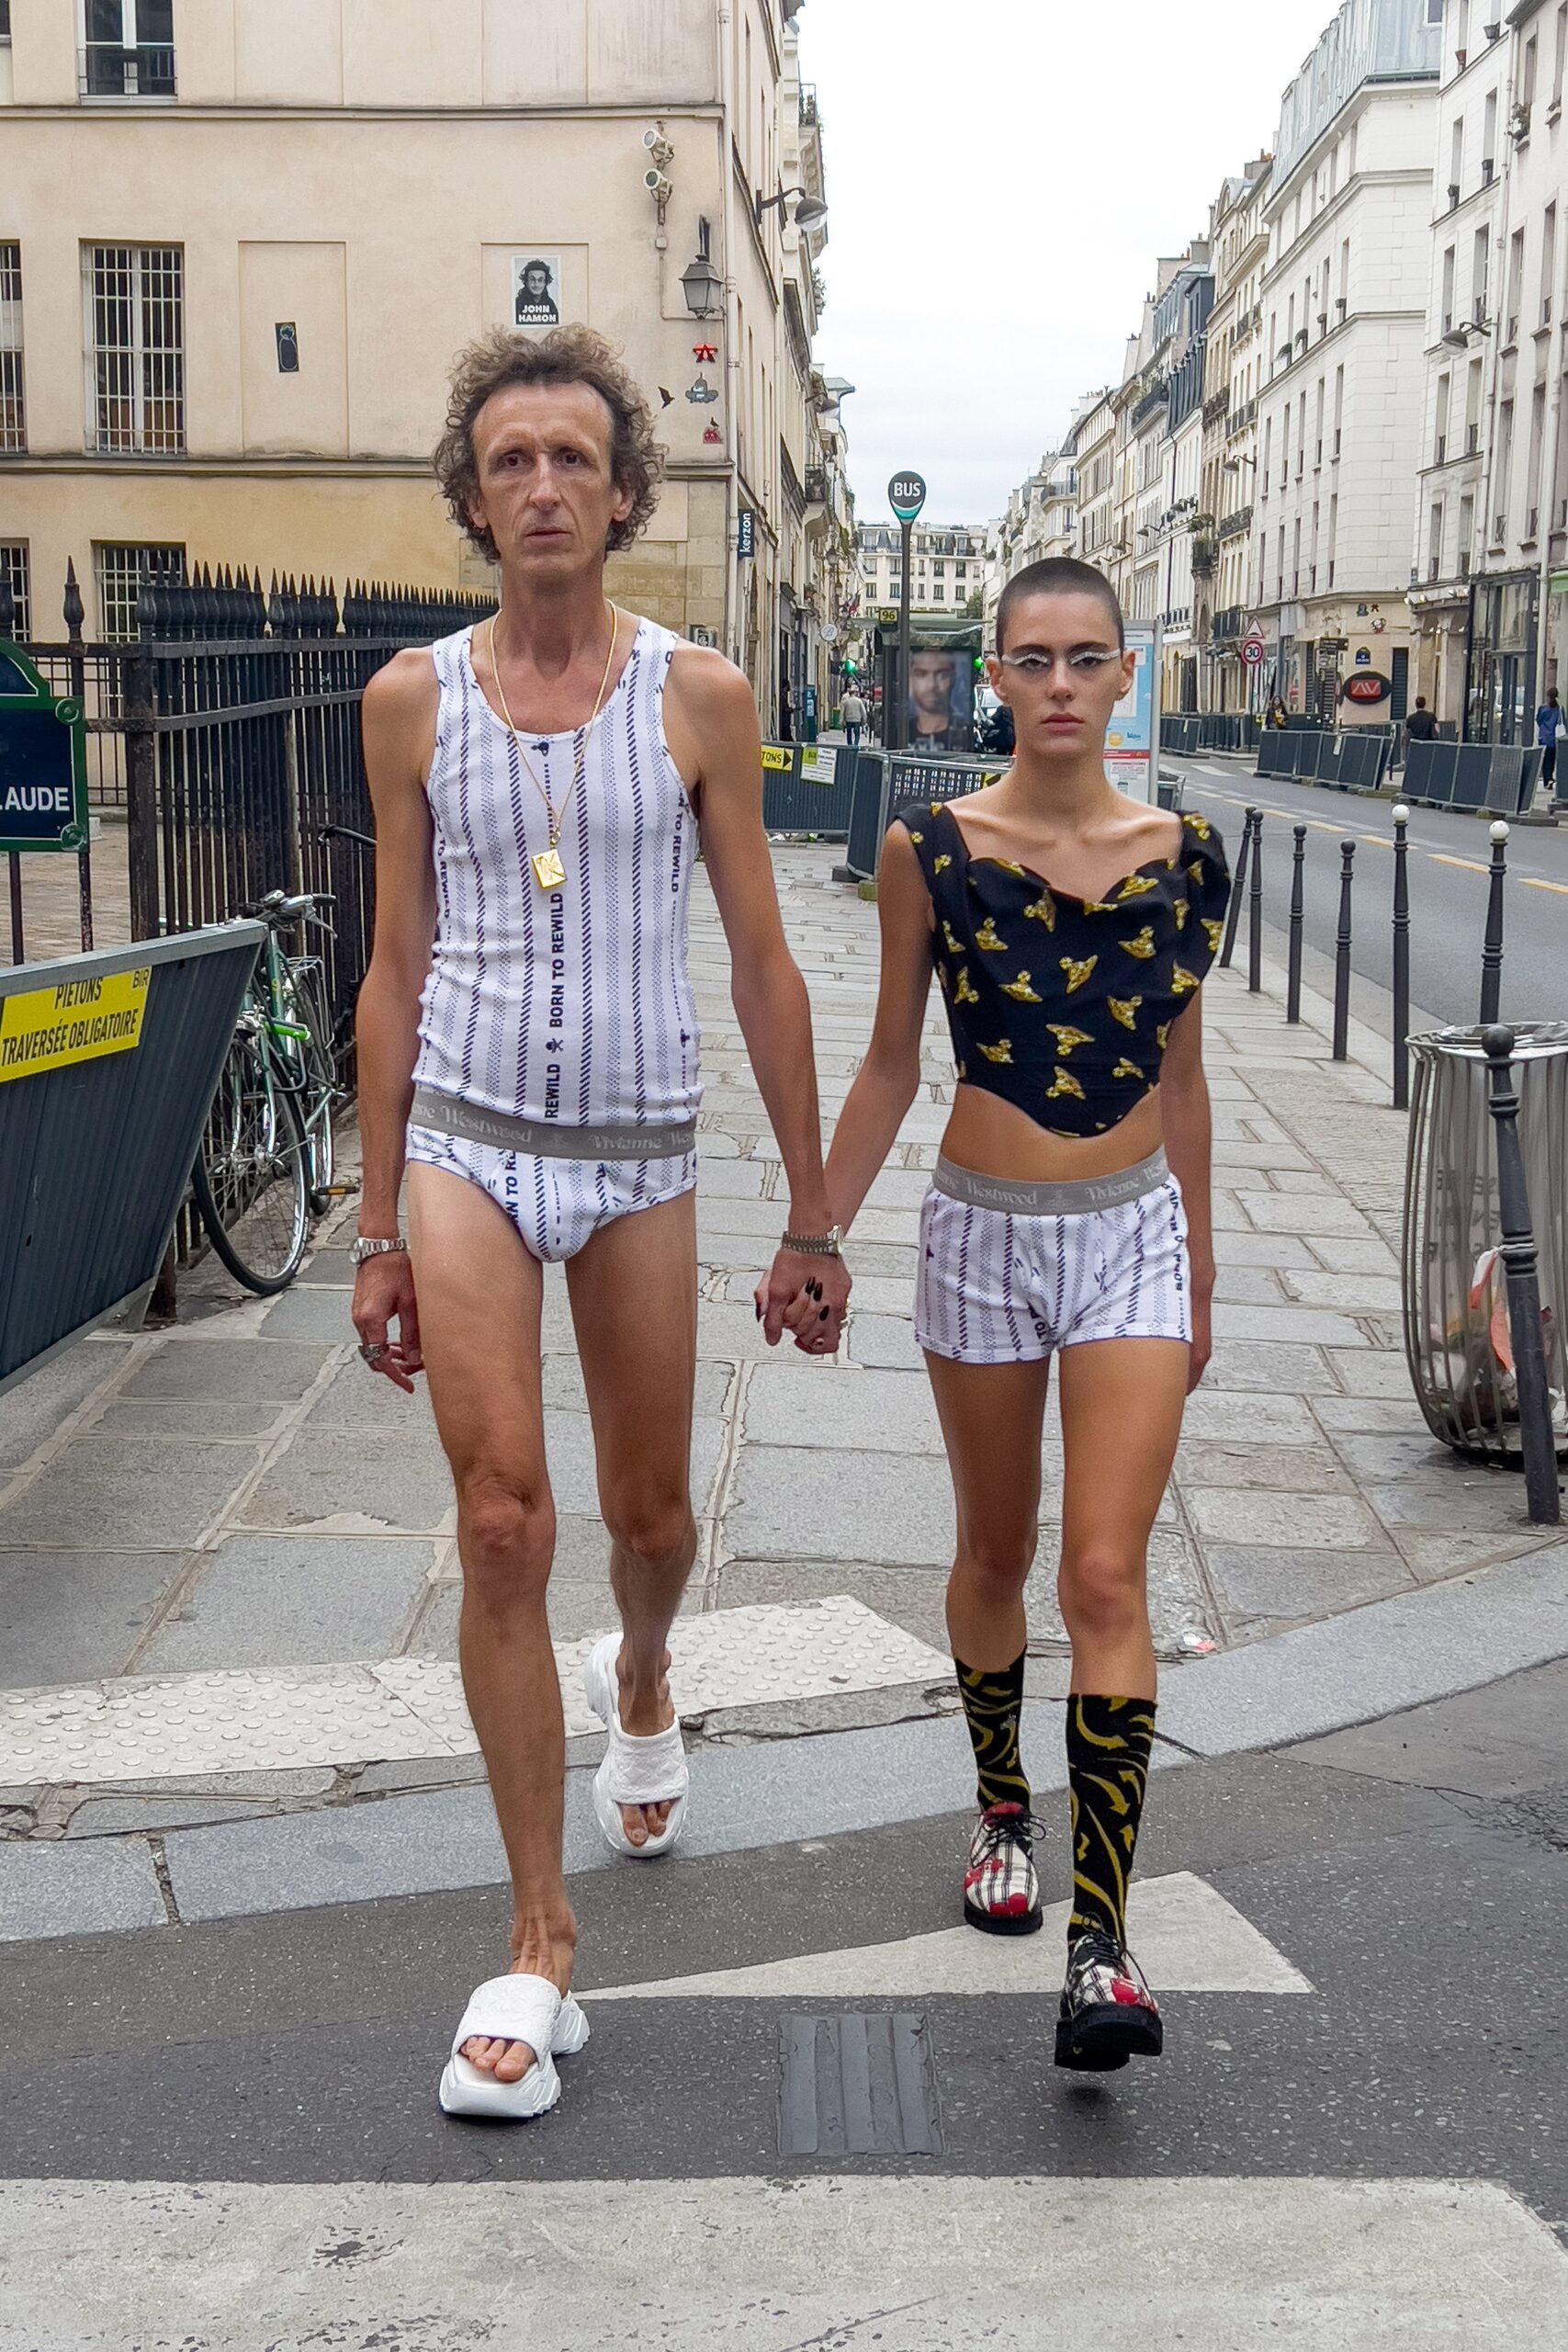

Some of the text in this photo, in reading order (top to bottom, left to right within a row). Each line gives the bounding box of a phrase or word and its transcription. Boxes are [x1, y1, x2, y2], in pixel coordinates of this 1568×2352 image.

[518, 313, 557, 322] HAMON
[522, 304, 550, 313] JOHN
[894, 481, 921, 497] BUS
[739, 513, 751, 553] kerzon
[882, 610, 896, 620] 96
[1246, 646, 1259, 658] 30
[0, 786, 70, 811] AUDE
[675, 812, 683, 831] TO
[671, 835, 682, 893] REWILD
[549, 892, 564, 1028] BORN TO REWILD
[132, 968, 150, 989] BIR
[2, 1008, 139, 1066] TRAVERSÉE OBLIGATOIRE
[545, 1063, 560, 1119] REWILD
[506, 1176, 518, 1196] TO
